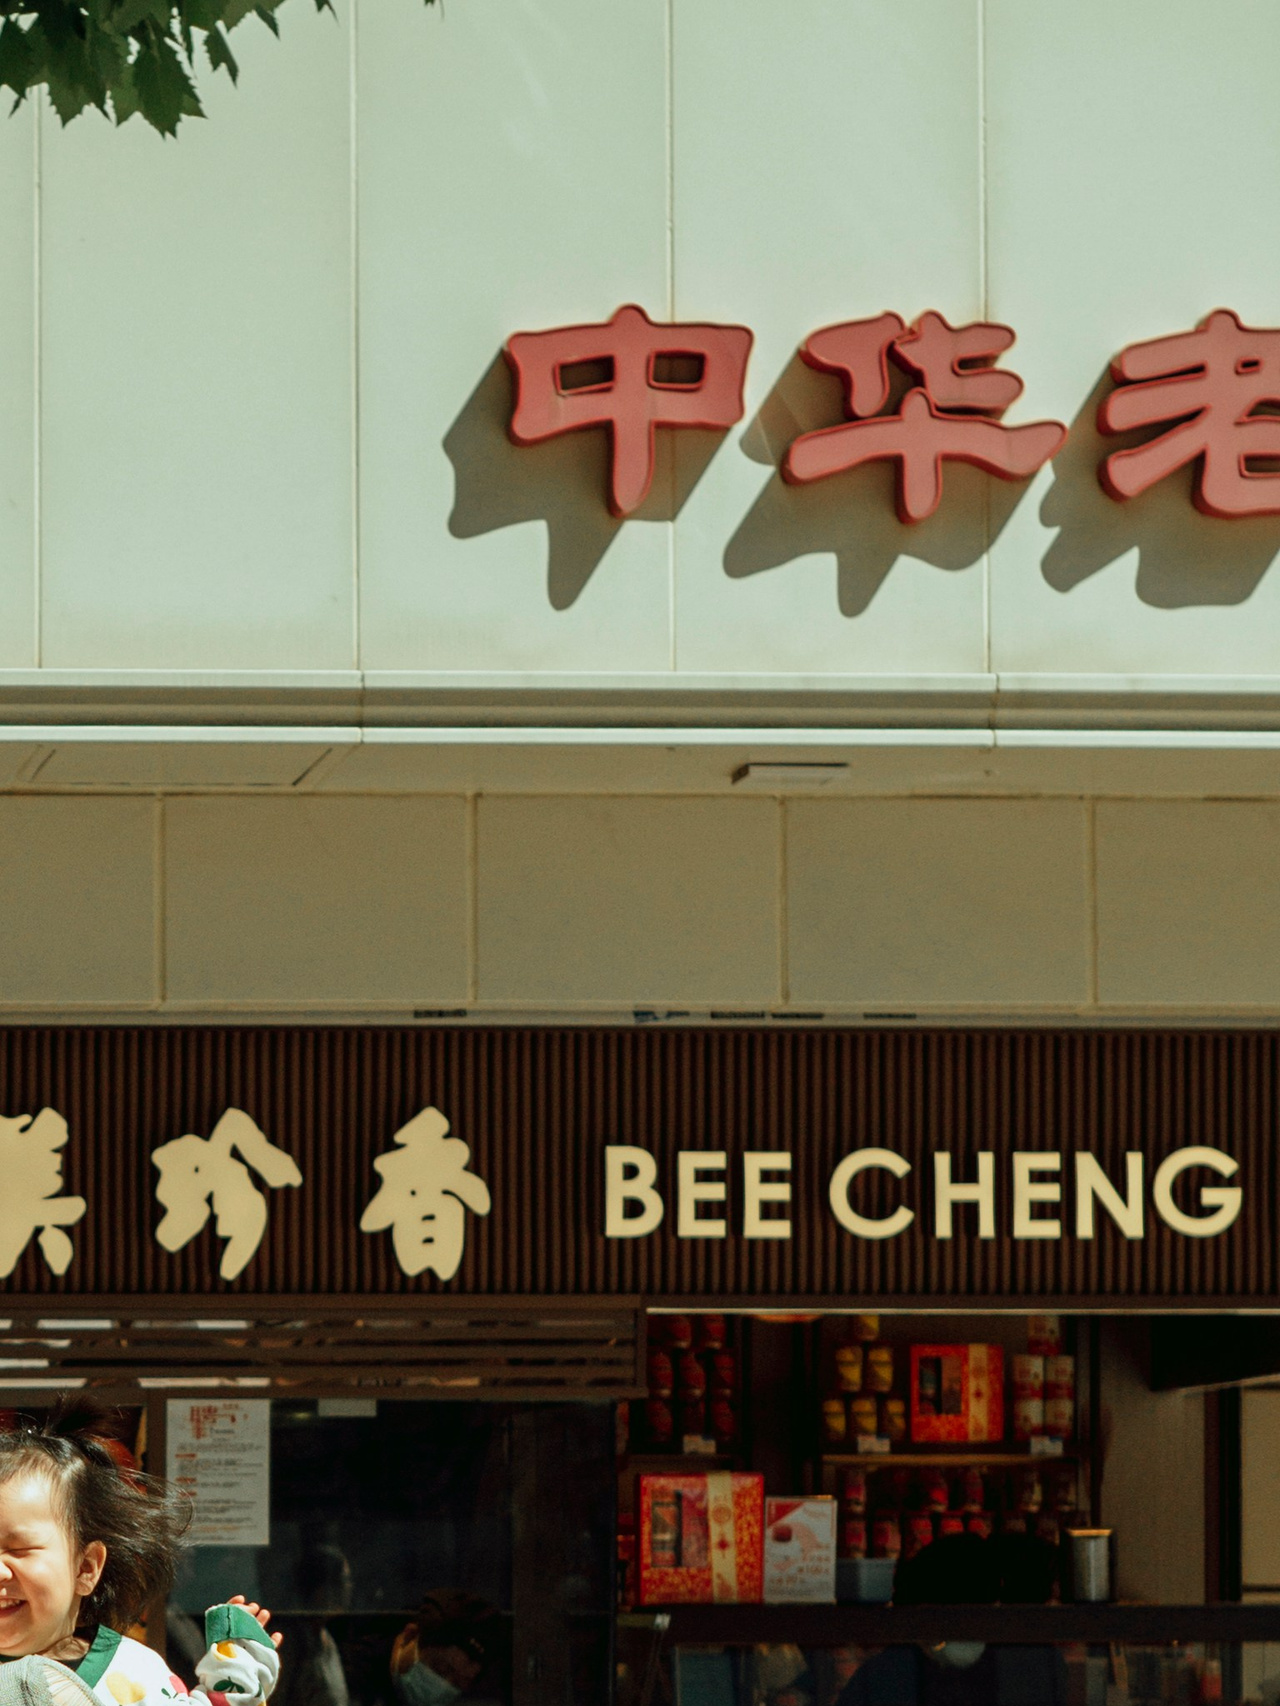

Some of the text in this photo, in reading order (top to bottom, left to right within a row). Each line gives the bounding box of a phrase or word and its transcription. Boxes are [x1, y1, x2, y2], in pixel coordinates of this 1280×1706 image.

[505, 302, 1280, 526] 中华老
[604, 1144, 1244, 1239] BEE CHENG
